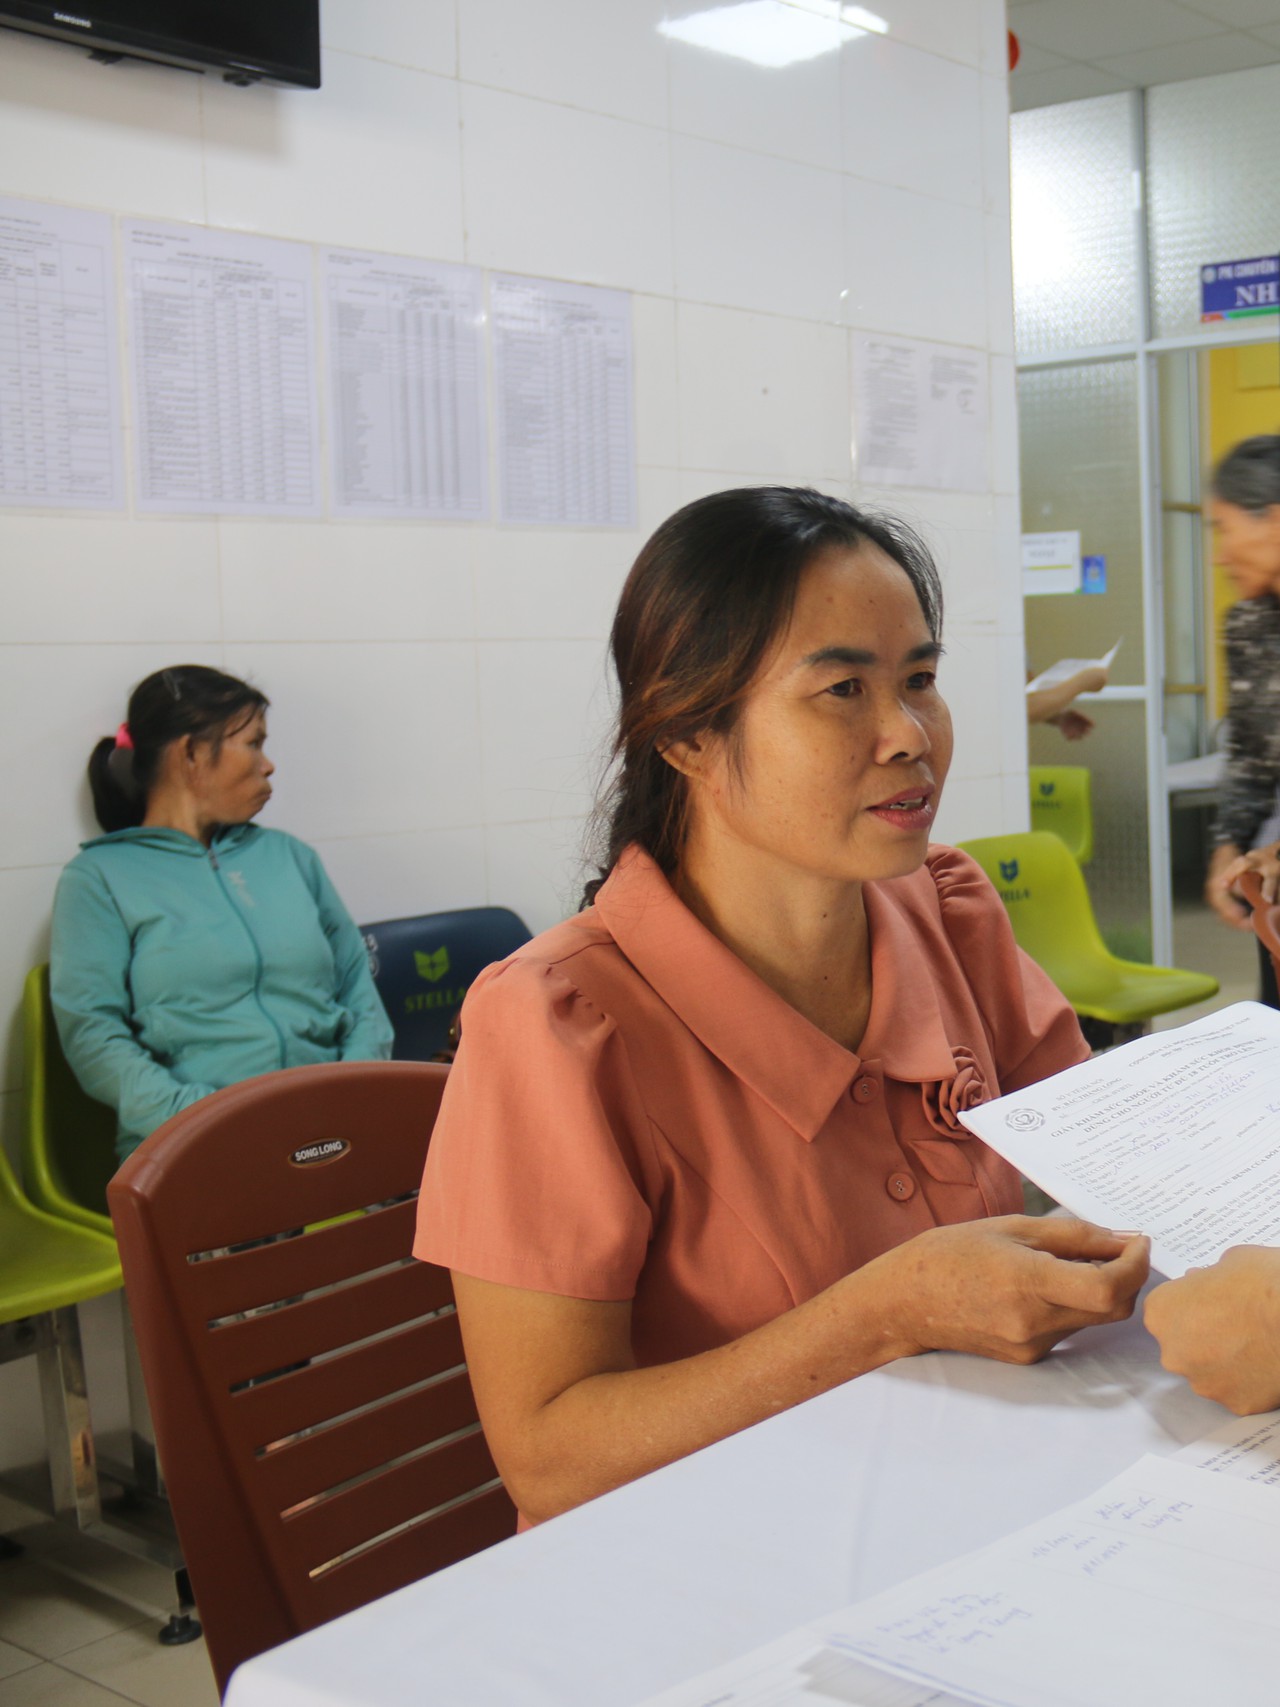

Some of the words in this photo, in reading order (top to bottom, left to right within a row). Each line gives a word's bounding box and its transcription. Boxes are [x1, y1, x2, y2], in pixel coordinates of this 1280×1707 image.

[53, 12, 92, 28] SAMSUNG
[1235, 281, 1279, 307] NH
[1110, 1106, 1132, 1119] CHO
[295, 1146, 319, 1162] SONG
[318, 1140, 343, 1155] LONG
